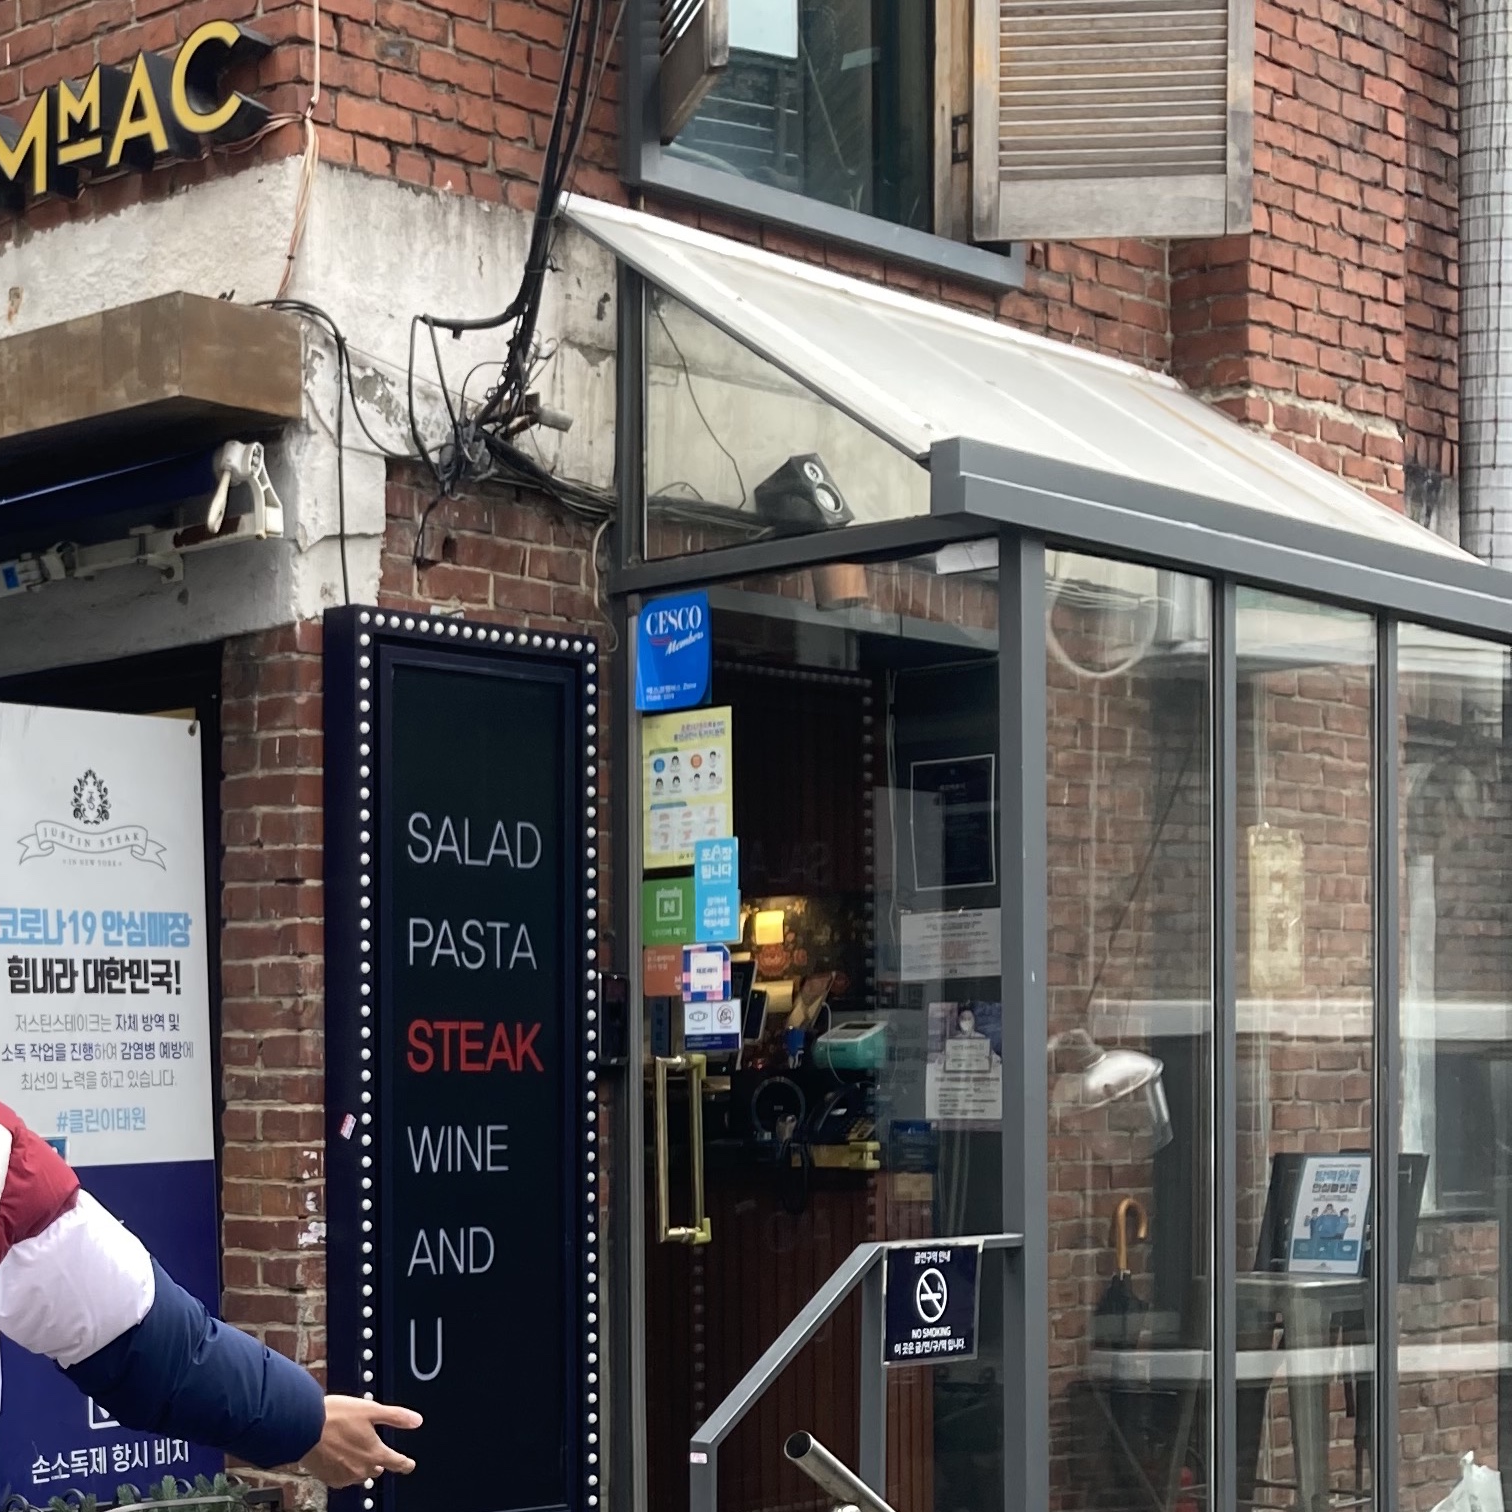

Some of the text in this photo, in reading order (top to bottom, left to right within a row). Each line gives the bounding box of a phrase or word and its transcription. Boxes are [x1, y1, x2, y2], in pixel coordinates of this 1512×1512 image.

[646, 605, 702, 635] CESCO
[44, 828, 140, 848] JUSTIN STEAK
[407, 811, 542, 869] SALAD
[102, 910, 192, 947] 안심매장
[408, 917, 537, 970] PASTA
[7, 955, 181, 995] 힘내라 대한민국!
[15, 1013, 180, 1033] 저스틴스테이크는 자체 방역 및
[1, 1041, 194, 1062] 소독 작업을 진행하여 감염병 예방에
[407, 1019, 543, 1073] STEAK
[21, 1072, 58, 1091] 최선의
[62, 1071, 97, 1090] 노력을
[101, 1070, 124, 1089] 하고
[56, 1107, 146, 1133] #클린이태원
[408, 1124, 508, 1173] WINE
[407, 1226, 495, 1277] AND
[409, 1316, 443, 1381] U
[912, 1326, 951, 1339] NO SMOKING
[32, 1446, 107, 1484] 손소독제
[112, 1440, 149, 1472] 항시
